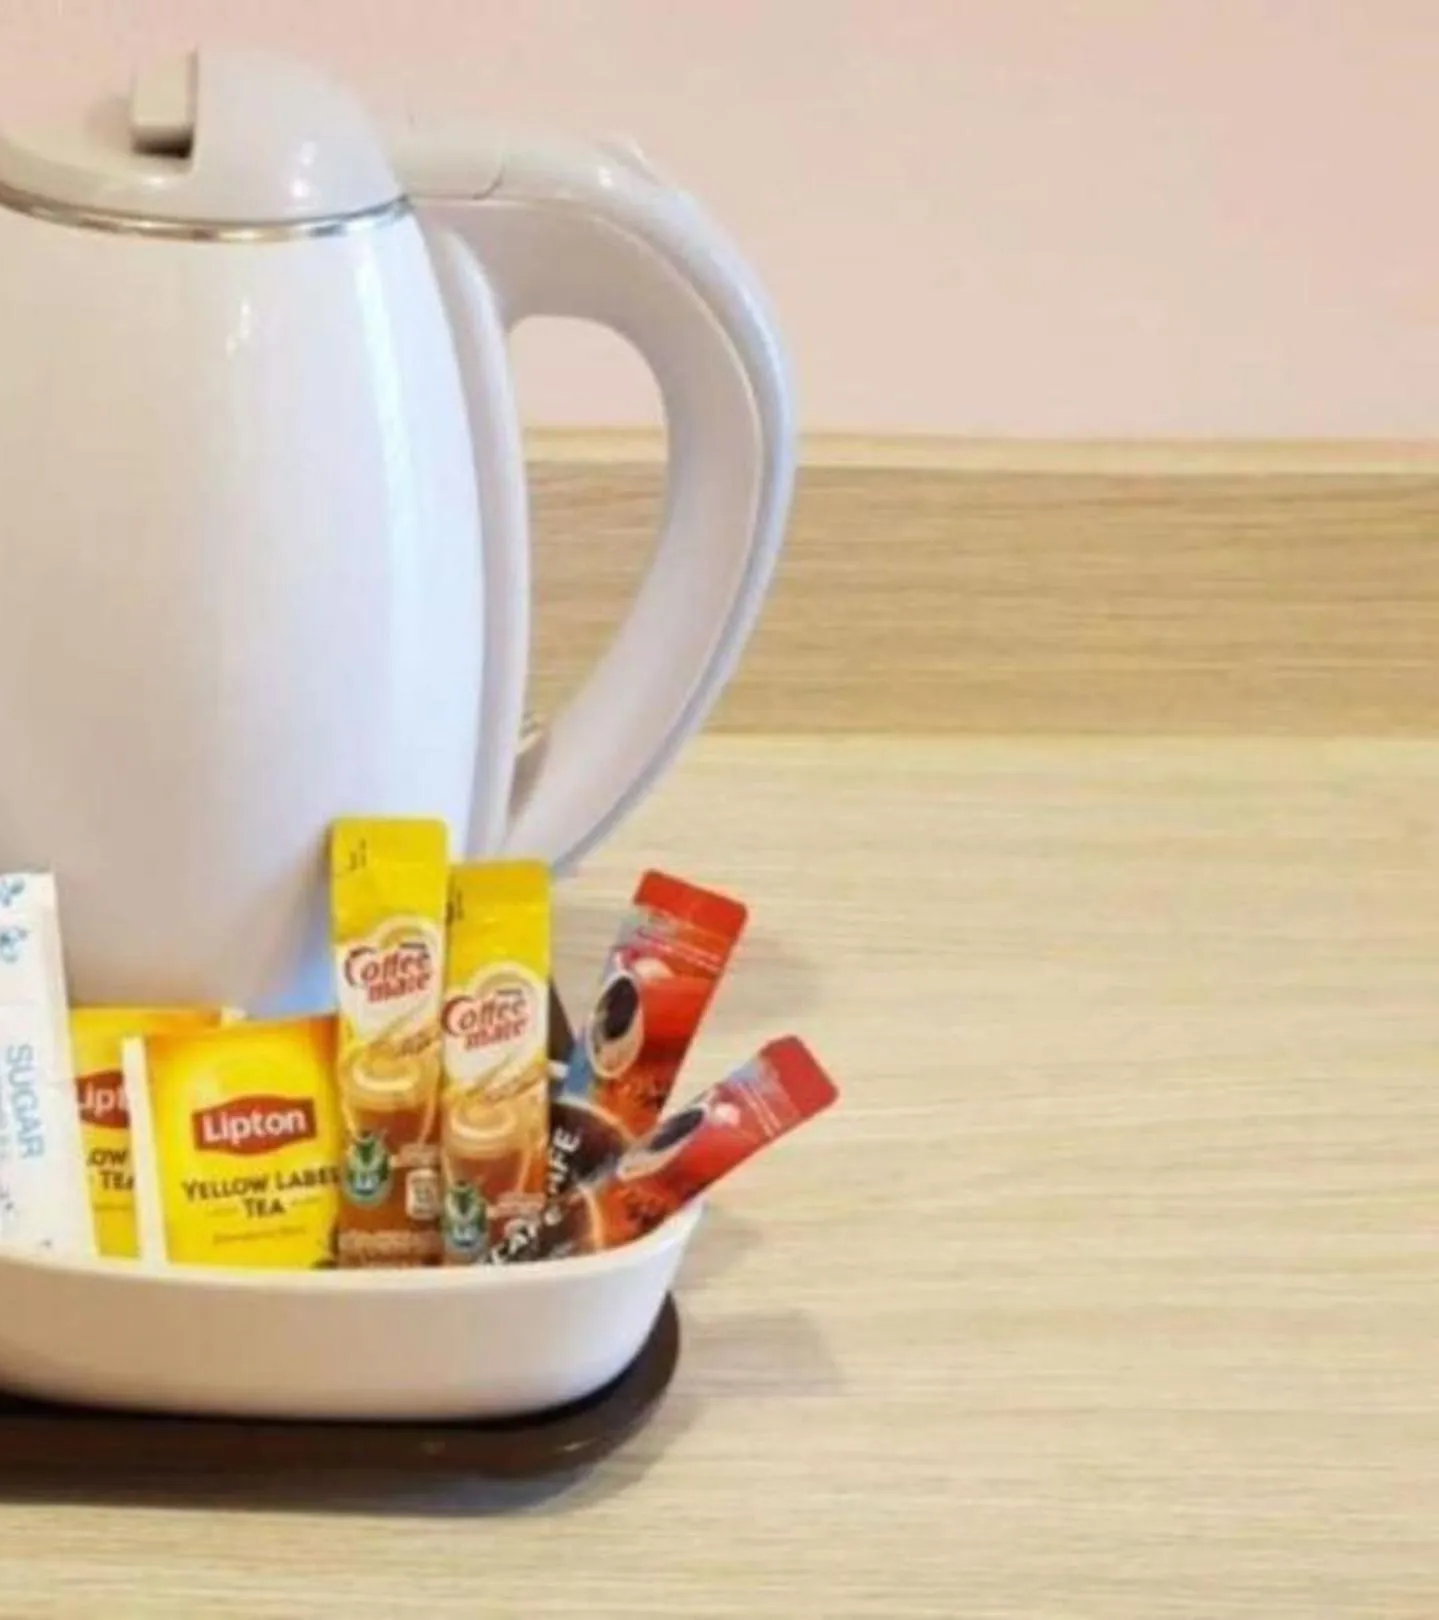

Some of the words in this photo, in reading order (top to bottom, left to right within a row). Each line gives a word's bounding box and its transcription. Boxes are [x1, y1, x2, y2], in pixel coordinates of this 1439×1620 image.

[344, 946, 431, 987] Coffee
[440, 994, 527, 1037] Coffee
[5, 1043, 46, 1159] SUGAR
[201, 1108, 308, 1148] Lipton
[180, 1172, 269, 1203] YELLOW
[243, 1197, 287, 1219] TEA
